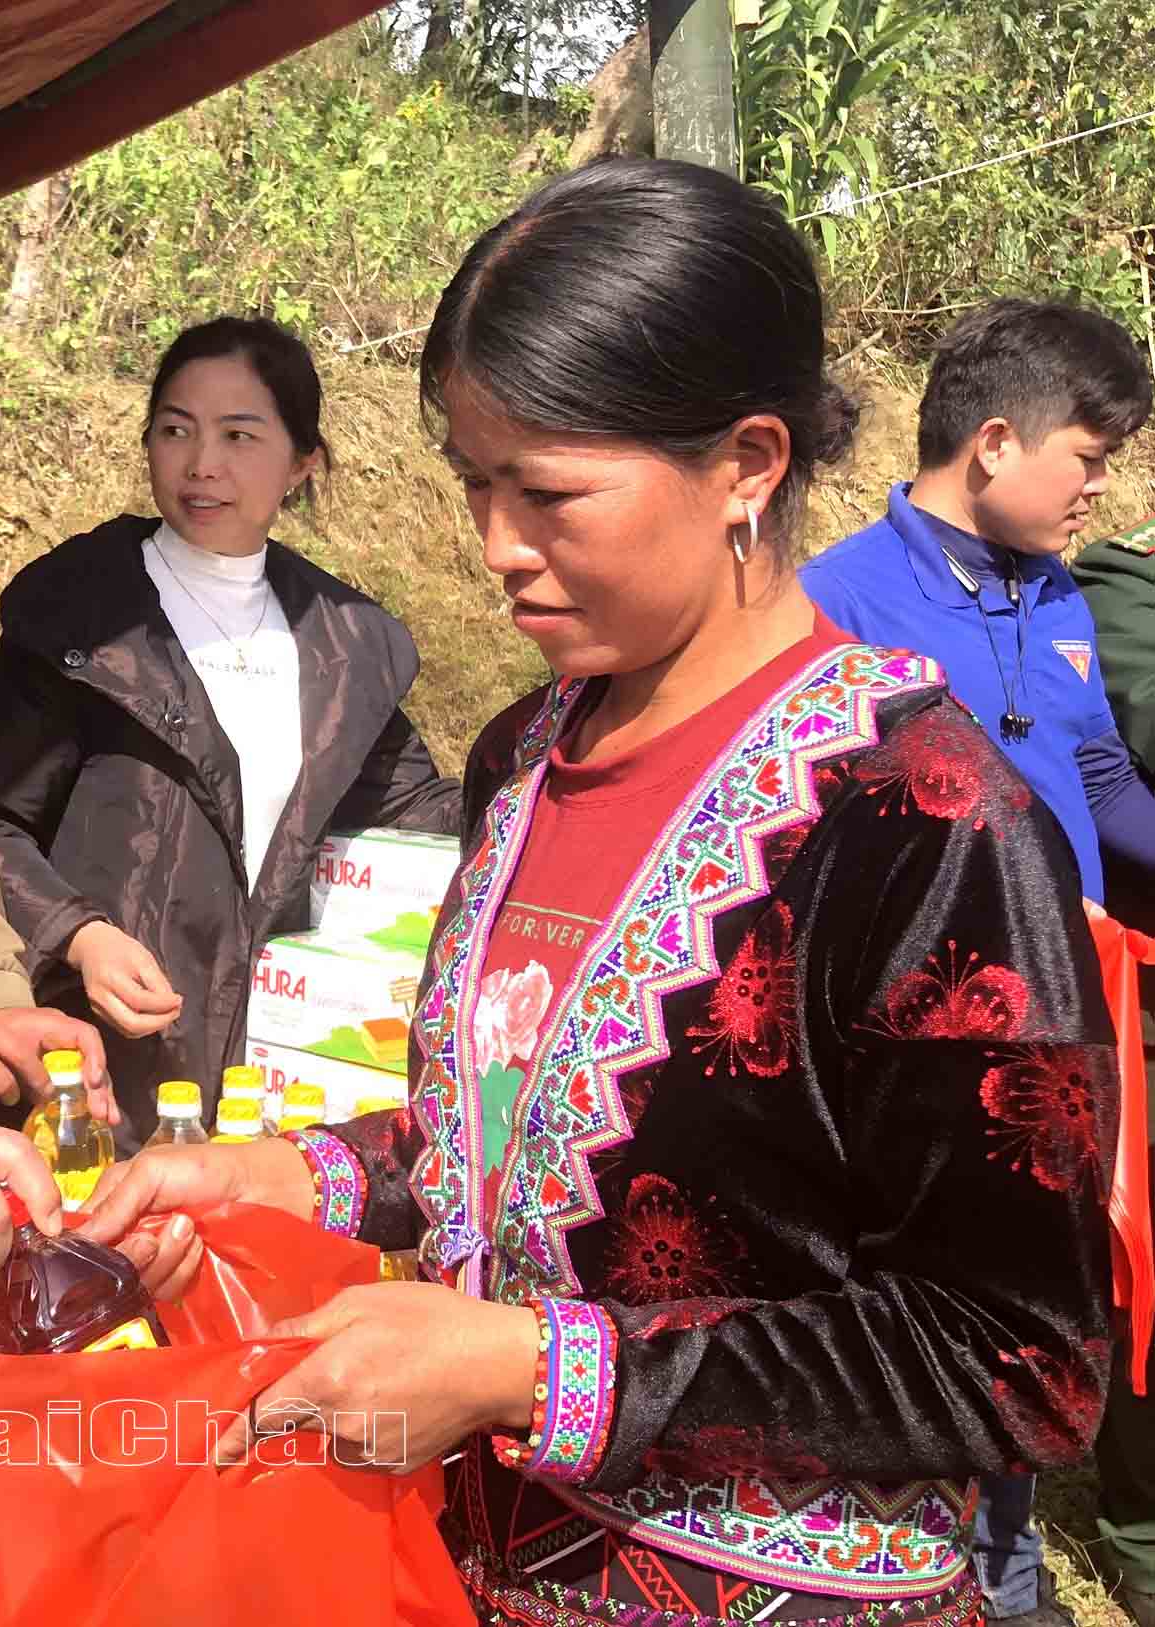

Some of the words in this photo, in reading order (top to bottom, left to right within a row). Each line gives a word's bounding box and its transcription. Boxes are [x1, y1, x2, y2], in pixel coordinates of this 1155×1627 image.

[315, 856, 372, 890] HURA
[499, 911, 586, 950] FORVER
[252, 963, 306, 1002] HURA
